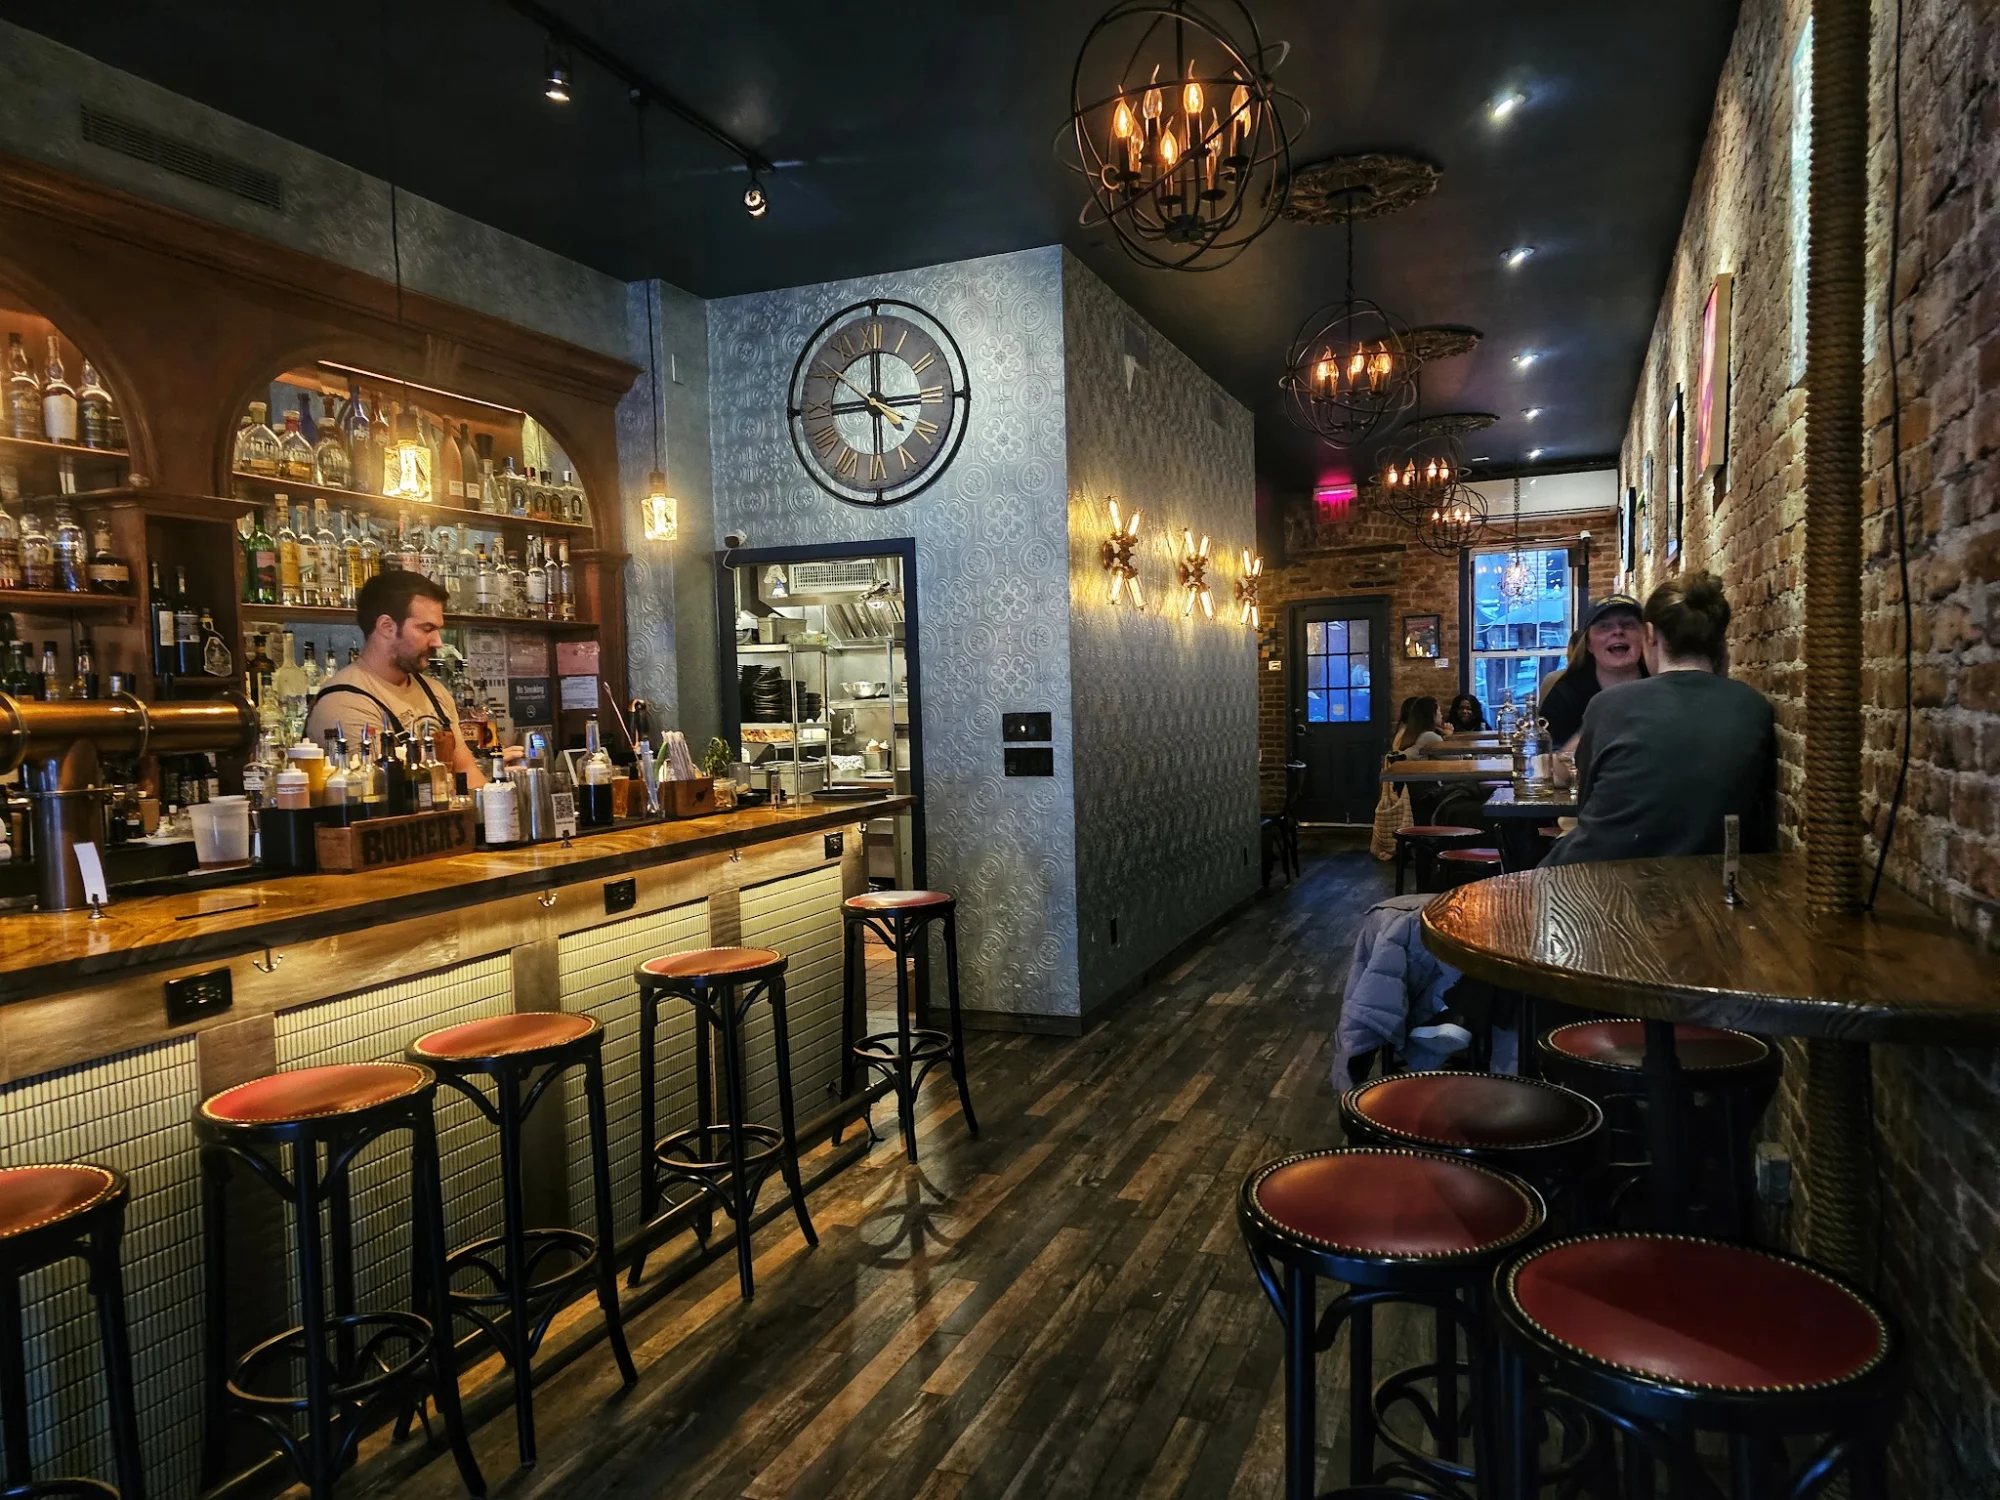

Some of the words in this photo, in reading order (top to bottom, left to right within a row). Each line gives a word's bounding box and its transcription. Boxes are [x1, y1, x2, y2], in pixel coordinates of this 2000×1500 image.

[831, 333, 856, 365] XI
[860, 323, 883, 351] XII
[894, 330, 908, 354] I
[912, 352, 936, 375] II
[920, 385, 944, 404] III
[807, 399, 831, 421] IX
[813, 424, 840, 459] VIII
[914, 418, 940, 445] IV
[835, 446, 859, 480] VII
[869, 454, 888, 481] VI
[897, 445, 918, 471] V
[1318, 499, 1350, 523] EXIT
[516, 685, 523, 694] No
[524, 685, 545, 695] Smoking
